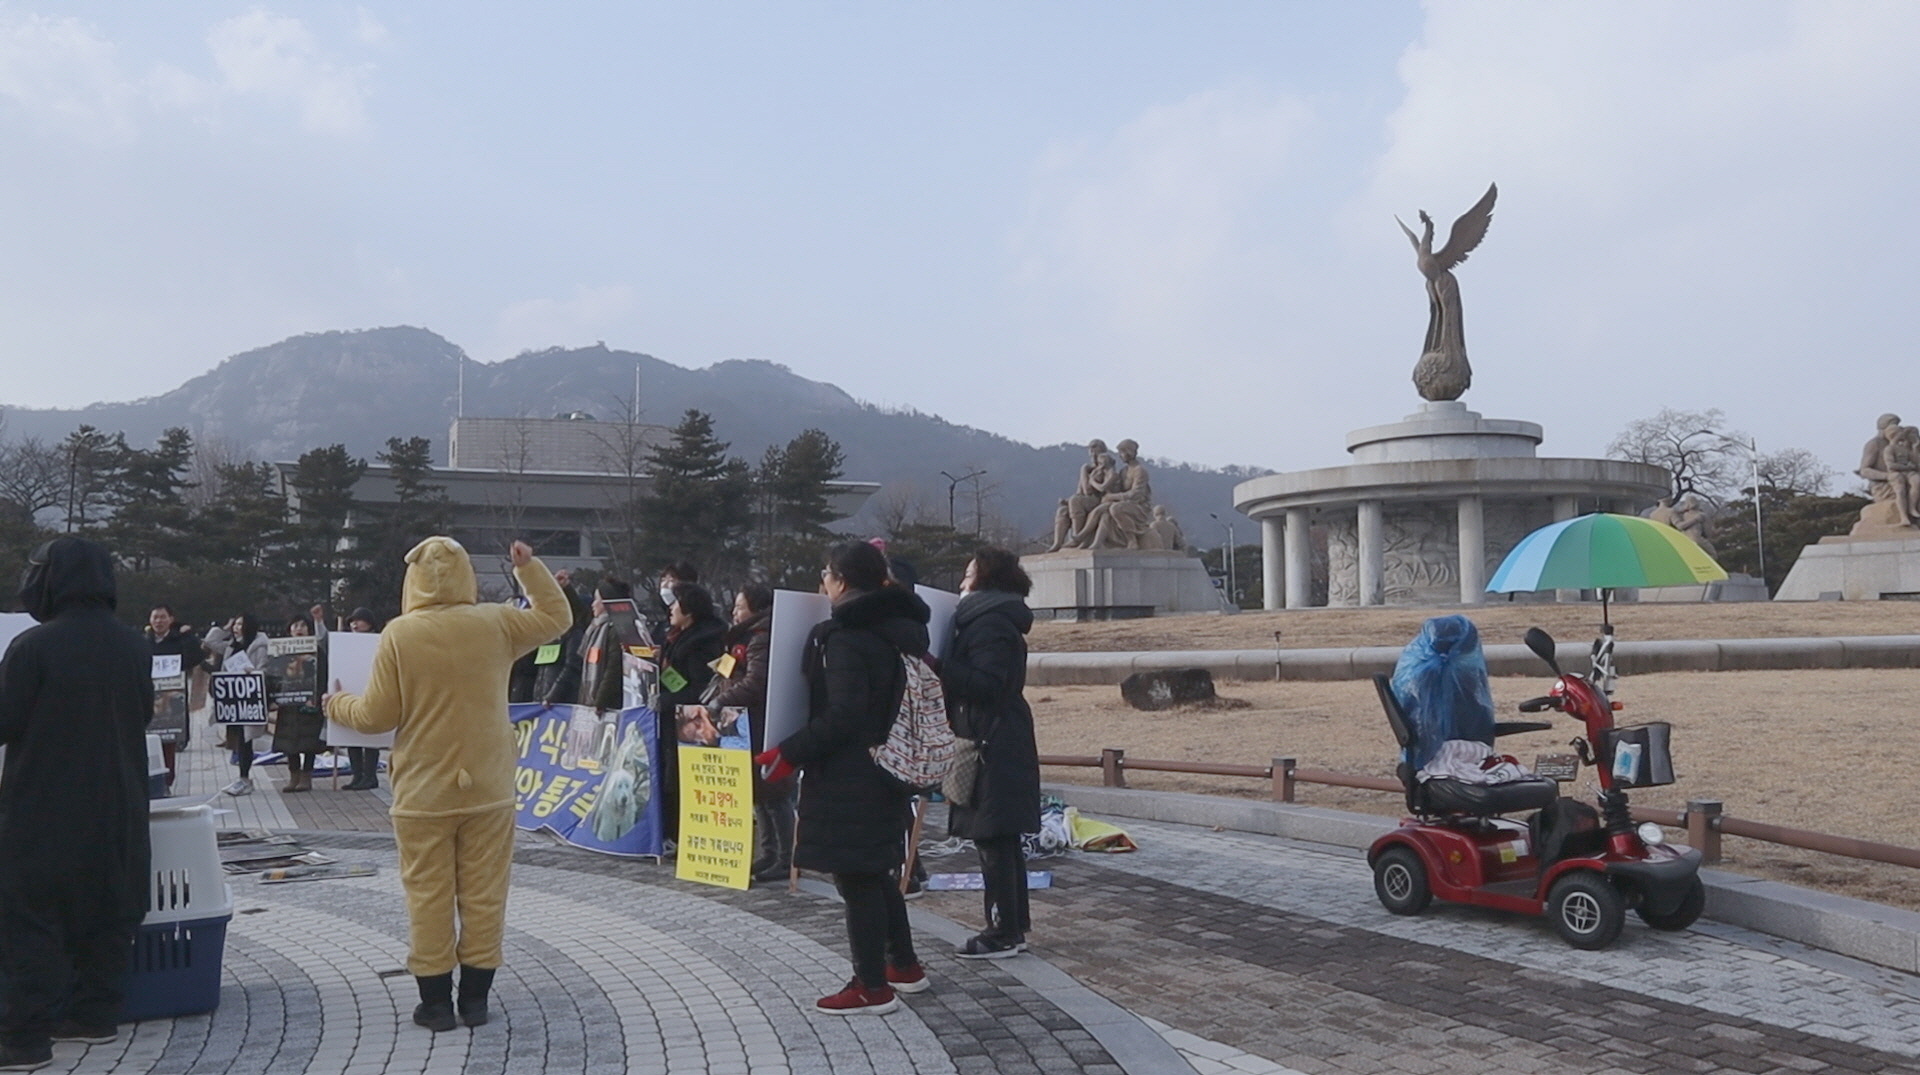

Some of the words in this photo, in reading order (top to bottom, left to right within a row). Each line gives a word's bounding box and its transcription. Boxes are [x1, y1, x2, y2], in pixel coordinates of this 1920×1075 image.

[214, 676, 262, 699] STOP!
[216, 700, 237, 722] Dog
[238, 700, 265, 721] Meat
[709, 837, 744, 855] 가족입니다
